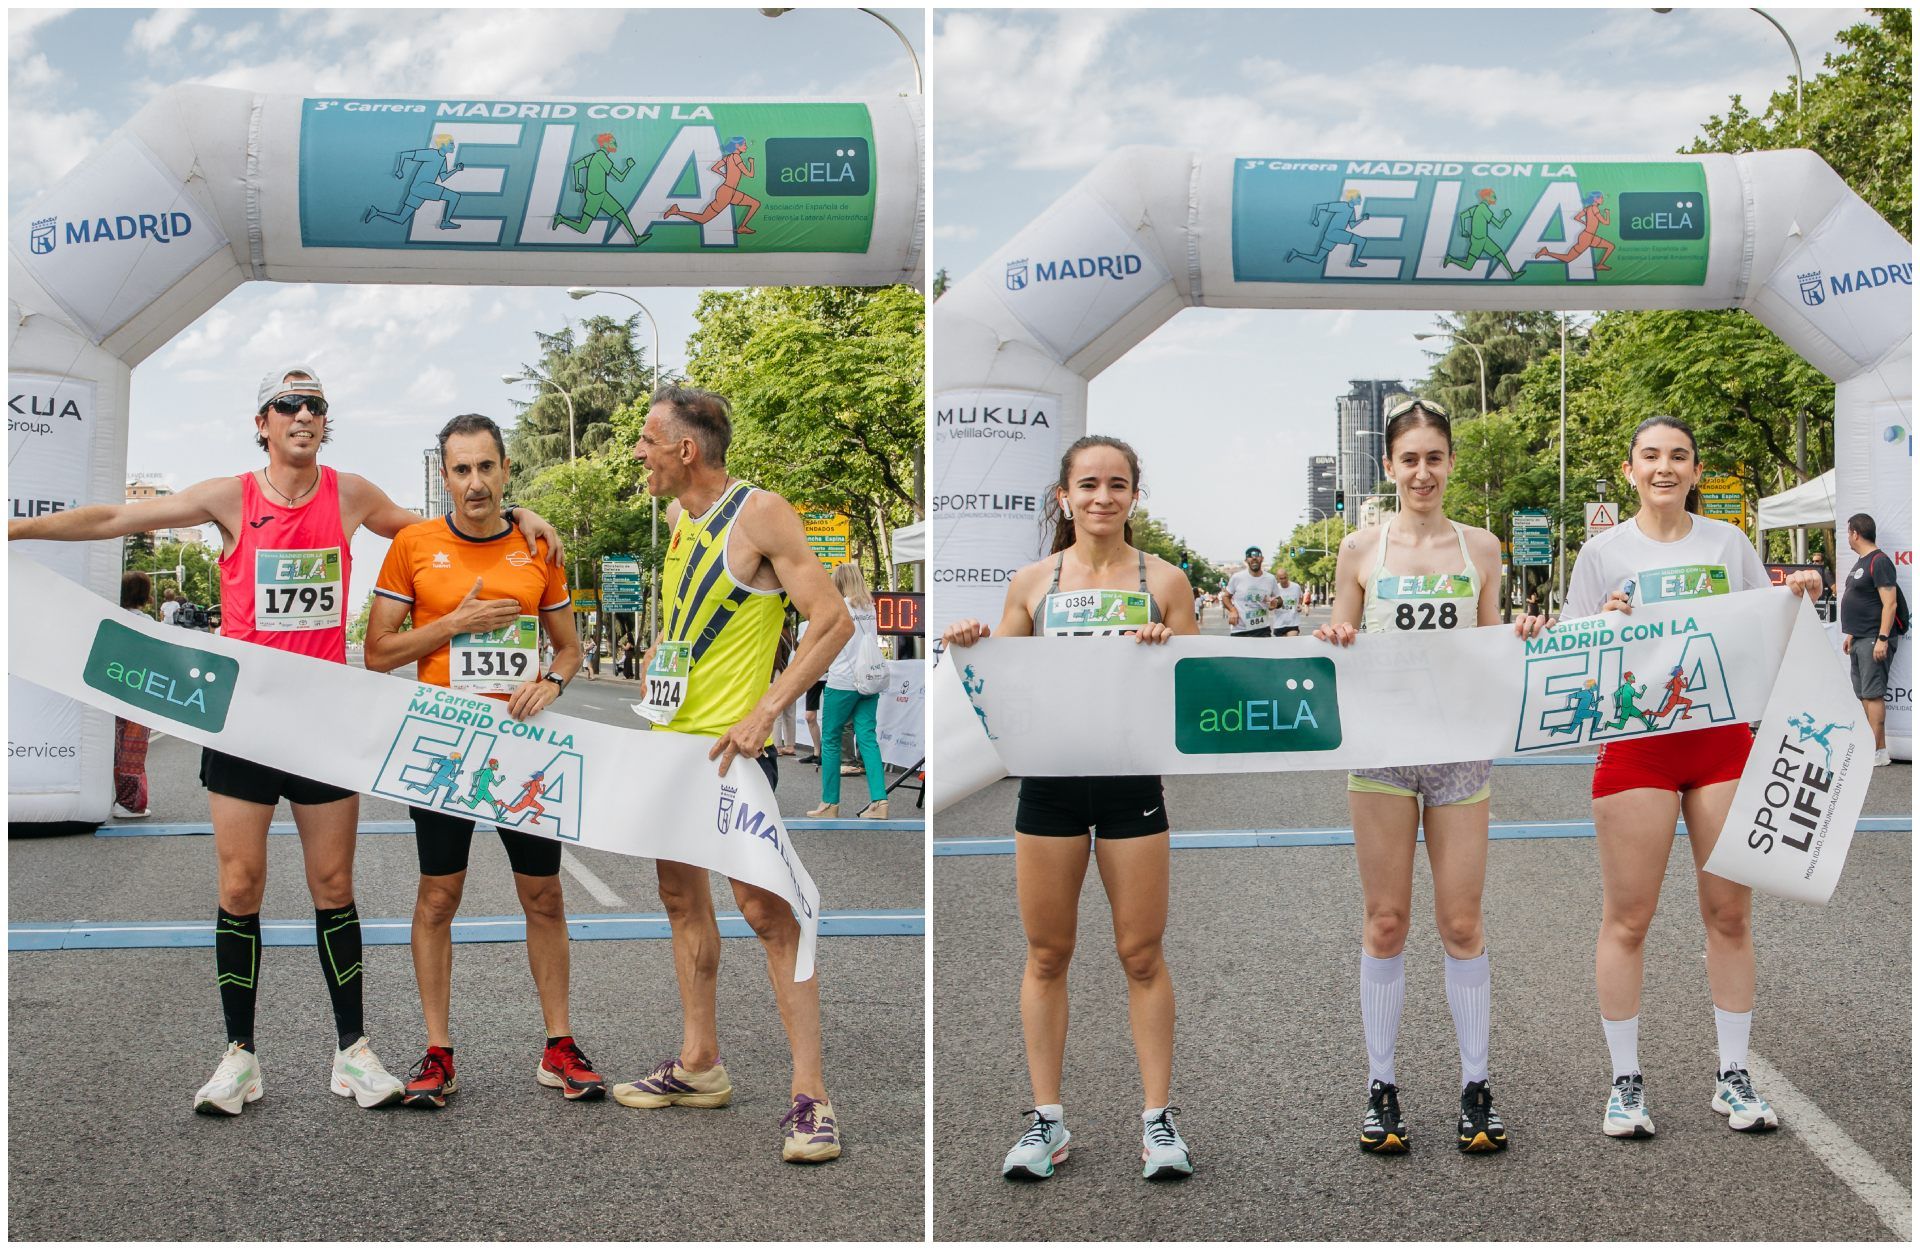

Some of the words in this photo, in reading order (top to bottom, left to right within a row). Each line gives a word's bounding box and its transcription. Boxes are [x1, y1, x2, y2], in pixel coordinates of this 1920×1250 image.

[343, 101, 426, 114] Carrera
[436, 101, 577, 120] MADRID
[586, 102, 662, 121] CON
[671, 103, 715, 121] LA
[405, 121, 739, 247] ELA
[1268, 161, 1338, 172] Carrera
[1345, 161, 1464, 176] MADRID
[1471, 163, 1535, 177] CON
[1541, 163, 1578, 178] LA
[65, 211, 192, 244] MADRID
[1320, 178, 1598, 281] ELA
[1035, 253, 1142, 282] MADRID
[937, 407, 1050, 429] MUKUA
[949, 427, 1027, 442] VelillaGroup.
[1397, 573, 1454, 595] ELA
[1661, 571, 1713, 598] ELA
[265, 585, 335, 614] 1795
[1065, 595, 1095, 609] 0384
[1395, 602, 1458, 630] 828
[1525, 629, 1614, 656] MADRID
[1620, 620, 1664, 642] CON
[1671, 616, 1699, 636] LA
[461, 651, 528, 677] 1319
[434, 690, 493, 713] Carrera
[649, 679, 681, 708] 1224
[1515, 632, 1736, 752] ELA
[407, 698, 494, 730] MADRID
[498, 719, 545, 742] CON
[547, 730, 575, 749] LA
[371, 714, 584, 841] ELA
[1747, 734, 1805, 855] SPORT
[1781, 762, 1834, 853] LIFE
[1804, 838, 1824, 880] MOVILIDAD,
[1820, 785, 1842, 838] COMUNICACIÓN
[1841, 743, 1856, 776] EVENTOS
